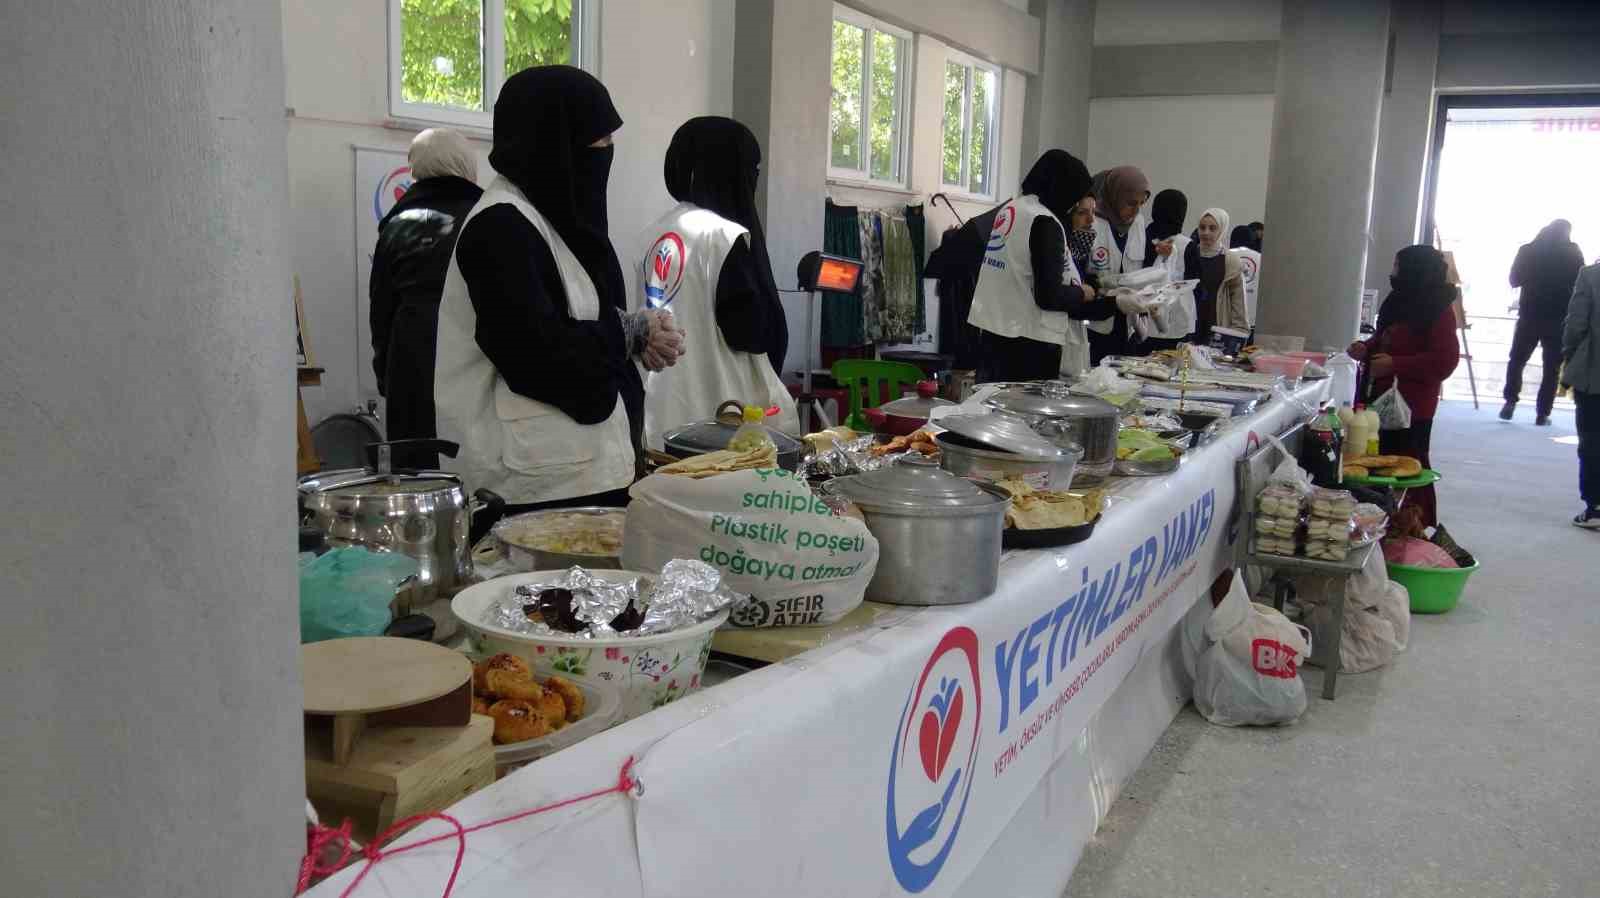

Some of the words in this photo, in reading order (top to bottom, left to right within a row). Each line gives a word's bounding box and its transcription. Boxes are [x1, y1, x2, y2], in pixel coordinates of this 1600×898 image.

[711, 514, 789, 545] Plastik
[700, 544, 795, 581] doğaya
[772, 611, 825, 627] ATIK
[774, 594, 825, 613] SIFIR
[995, 535, 1158, 734] YETİMLER
[1154, 488, 1216, 588] VAKFI
